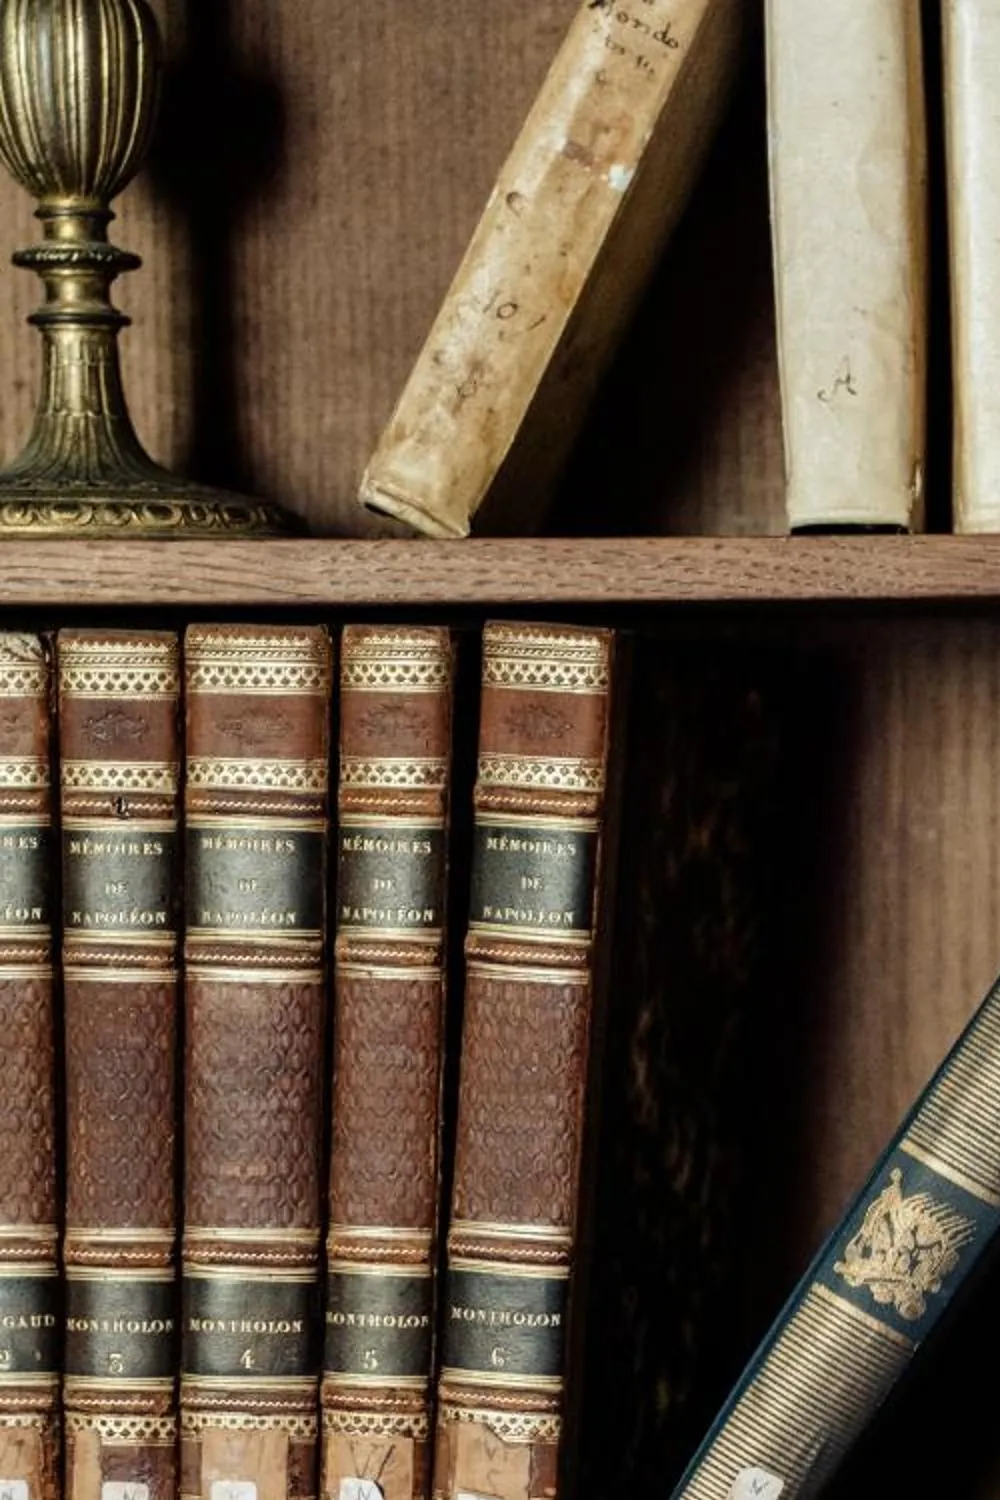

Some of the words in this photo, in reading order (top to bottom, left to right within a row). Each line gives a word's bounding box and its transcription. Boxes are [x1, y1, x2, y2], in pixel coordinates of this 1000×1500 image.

[70, 838, 163, 857] MÉMOIRES
[201, 836, 296, 854] MÉMOIRES
[342, 833, 432, 855] MÉMOIRES
[486, 835, 577, 857] MÉMOIRES
[104, 879, 128, 896] DE
[238, 878, 261, 893] DE
[373, 877, 395, 892] DE
[520, 876, 543, 891] DE
[71, 906, 167, 925] NAPOLÉON
[201, 907, 297, 926] NAPOLÉON
[341, 904, 434, 923] NAPOLÉON
[482, 905, 574, 924] NAPOLÉON
[67, 1318, 173, 1334] MONTHOLON
[188, 1317, 304, 1334] MONTHOLON
[326, 1311, 429, 1329] MONTHOLON
[451, 1307, 561, 1328] MONTHOLON
[239, 1348, 256, 1370] 4
[363, 1350, 378, 1370] 5
[490, 1346, 508, 1367] 6
